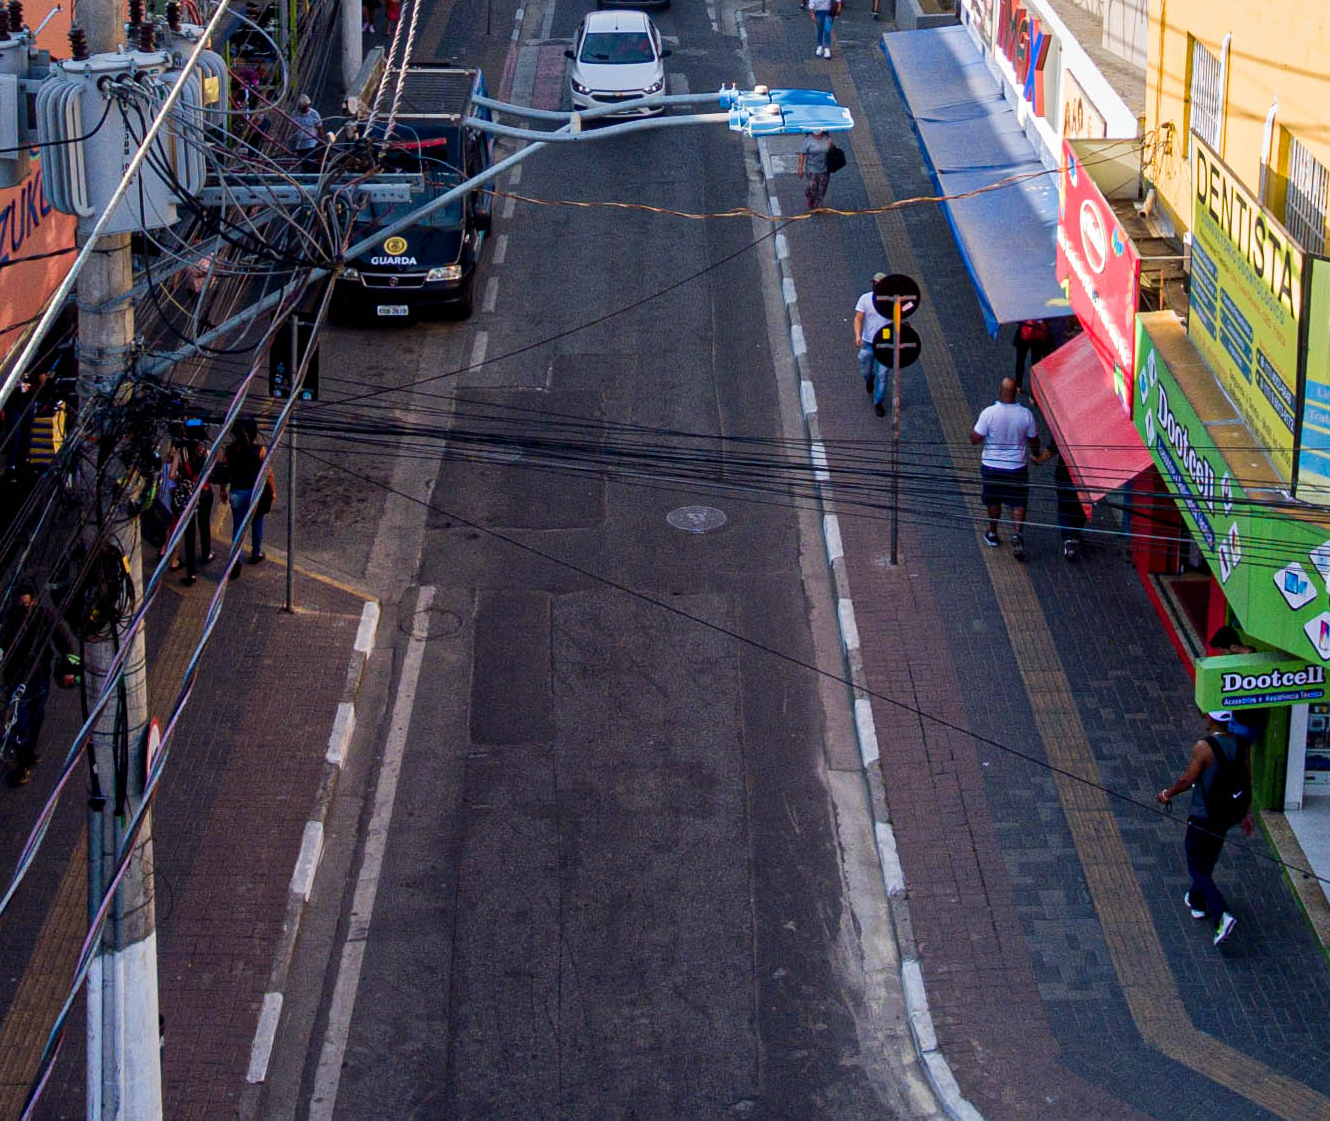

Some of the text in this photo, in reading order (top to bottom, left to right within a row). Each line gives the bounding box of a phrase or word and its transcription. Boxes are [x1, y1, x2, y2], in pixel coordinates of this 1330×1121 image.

[371, 256, 417, 265] GUARDA
[1197, 148, 1295, 320] DENTISTA
[1156, 381, 1216, 518] Dootcell
[1221, 664, 1326, 693] Dootcell
